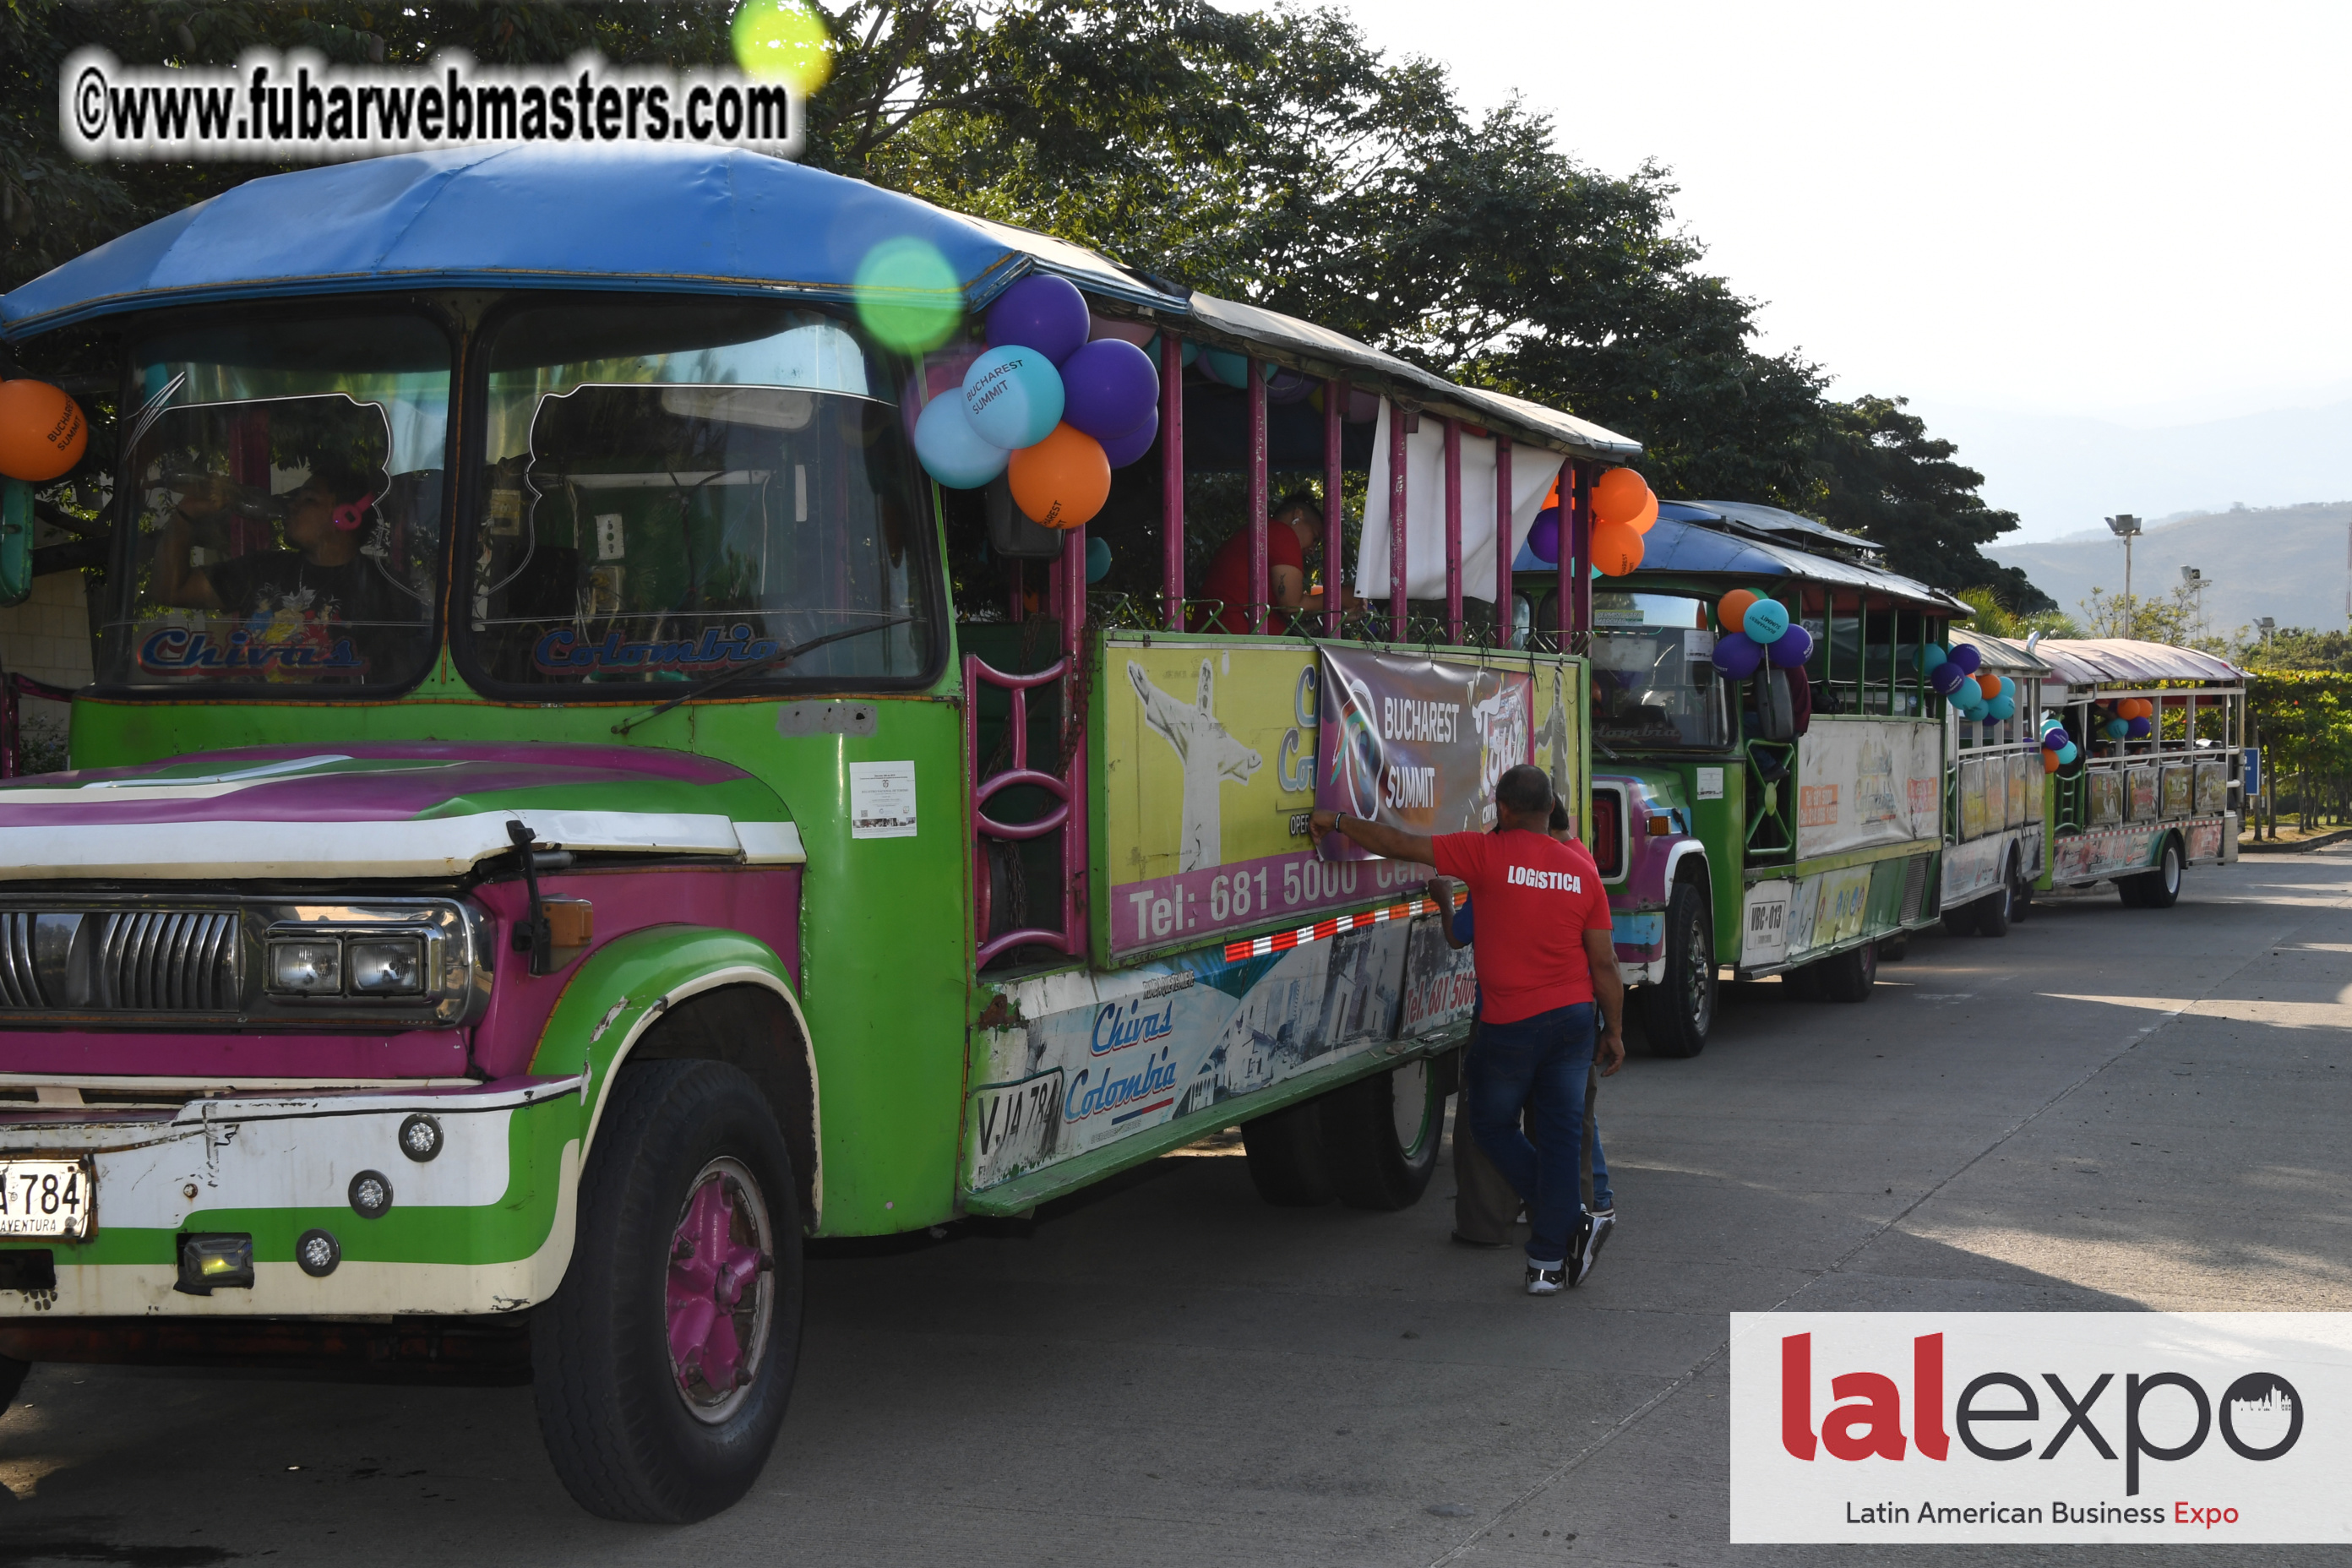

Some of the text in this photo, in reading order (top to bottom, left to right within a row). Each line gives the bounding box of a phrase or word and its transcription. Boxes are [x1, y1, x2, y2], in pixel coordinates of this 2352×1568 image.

[966, 359, 1024, 402] BUCHAREST
[972, 379, 1009, 415] SUMMIT
[57, 415, 81, 451] SUMMIT
[138, 627, 369, 677] Chivas
[534, 623, 791, 675] Colombia
[1384, 697, 1460, 743] BUCHAREST
[1385, 765, 1435, 808] SUMMIT
[1130, 884, 1195, 940] Tel:
[1210, 866, 1268, 923] 681
[1282, 858, 1358, 906] 5000
[1506, 865, 1582, 894] LOGISTICA
[1427, 976, 1450, 1016] 681
[1090, 999, 1173, 1057] Chivas
[1064, 1046, 1177, 1124] Colombia
[19, 1173, 80, 1215] 784
